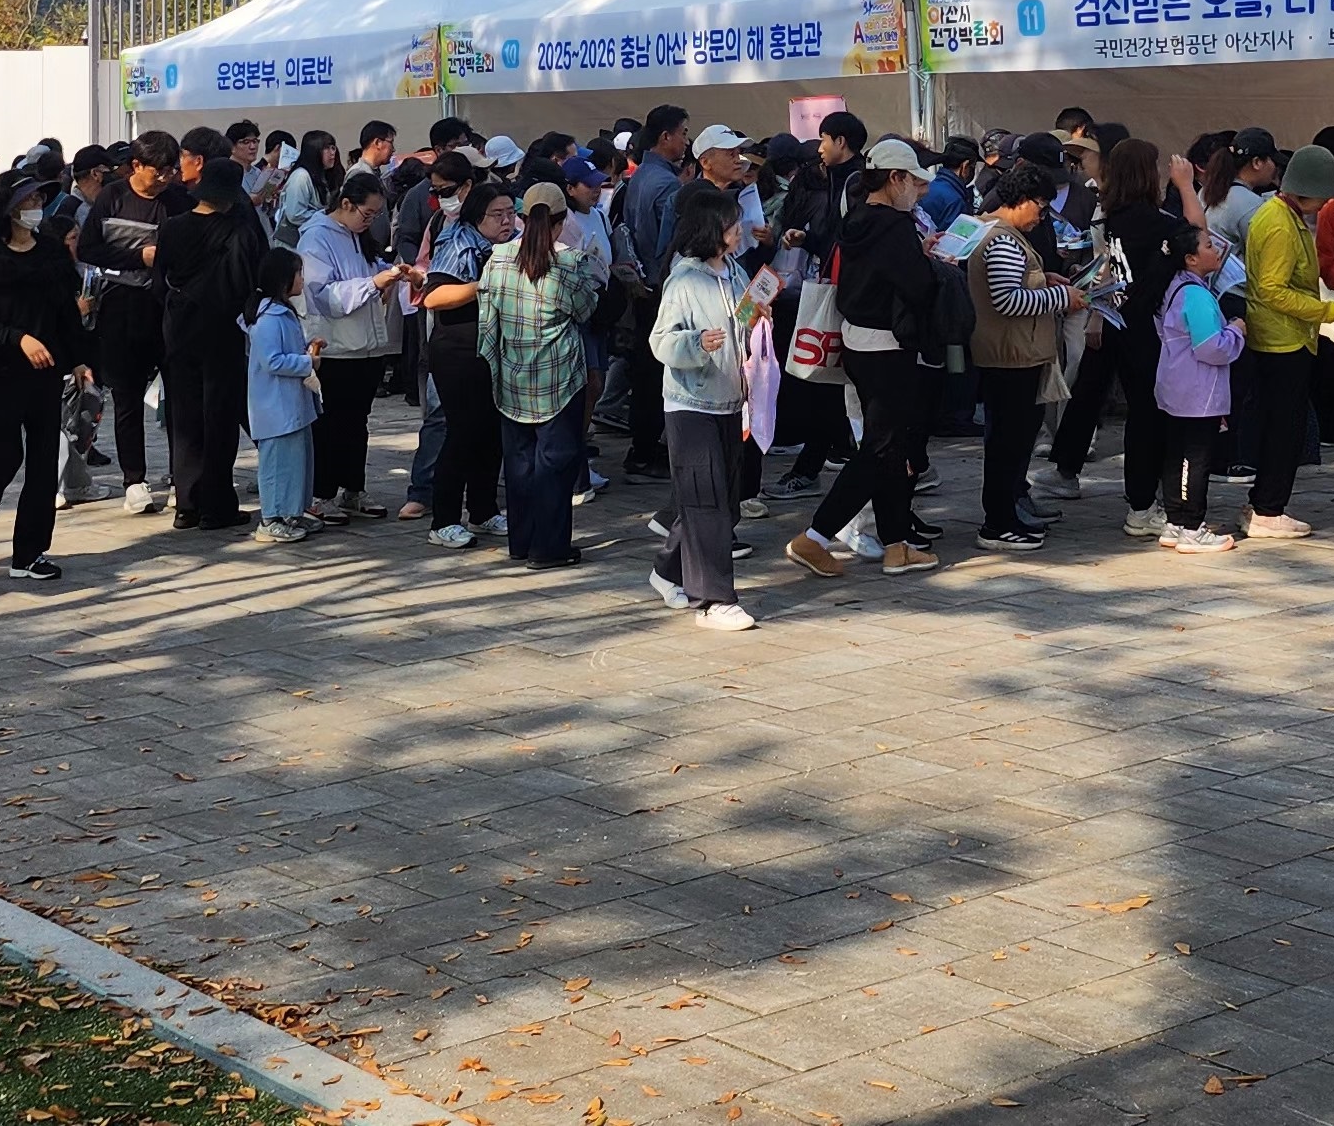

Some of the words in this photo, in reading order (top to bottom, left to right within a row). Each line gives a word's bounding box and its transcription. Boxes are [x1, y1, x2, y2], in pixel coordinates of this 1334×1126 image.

[927, 5, 971, 25] 아산시
[1023, 5, 1039, 31] 11
[537, 38, 616, 70] 2025~2026
[620, 34, 651, 69] 충남
[656, 31, 687, 66] 아산
[692, 27, 741, 64] 방문의
[747, 25, 764, 61] 해
[769, 21, 822, 60] 홍보관
[929, 20, 1004, 52] 건강박람회
[1094, 35, 1218, 60] 국민건강보험공단
[1225, 29, 1295, 54] 아산지사
[447, 53, 495, 77] 건강박람회
[505, 43, 517, 64] 10
[217, 60, 280, 90] 운영본부,
[285, 55, 334, 86] 의료반
